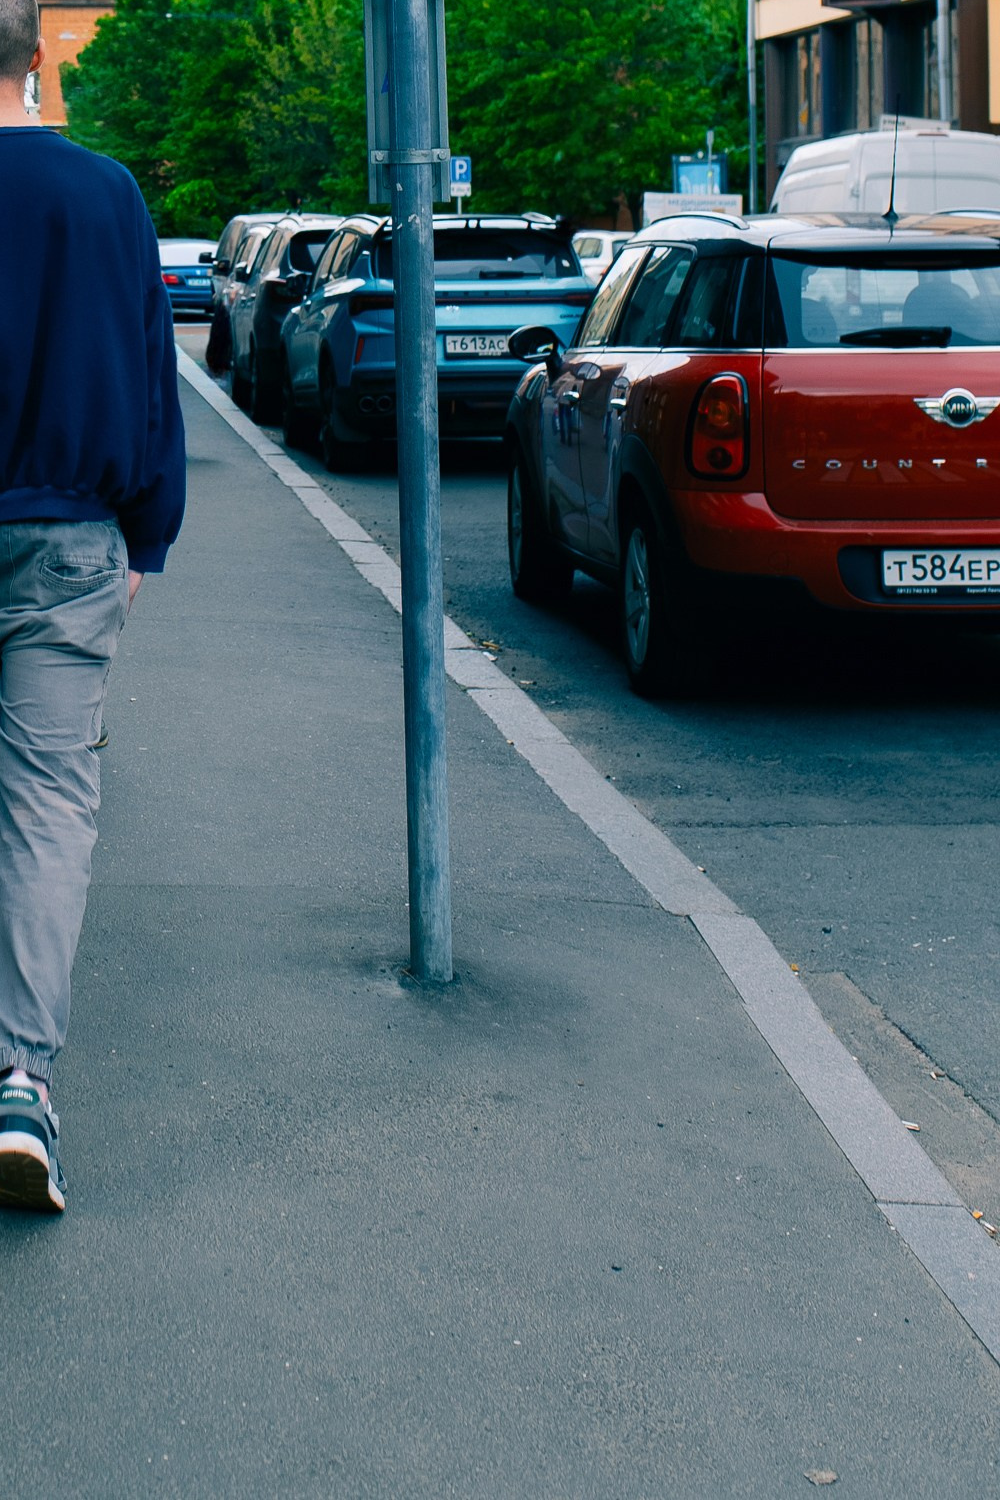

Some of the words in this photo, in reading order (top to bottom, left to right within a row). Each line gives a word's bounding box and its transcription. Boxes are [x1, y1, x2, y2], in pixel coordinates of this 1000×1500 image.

[455, 160, 468, 181] P
[946, 403, 975, 414] MINI
[792, 458, 989, 469] COUNTR
[2, 1088, 33, 1102] Reebok
